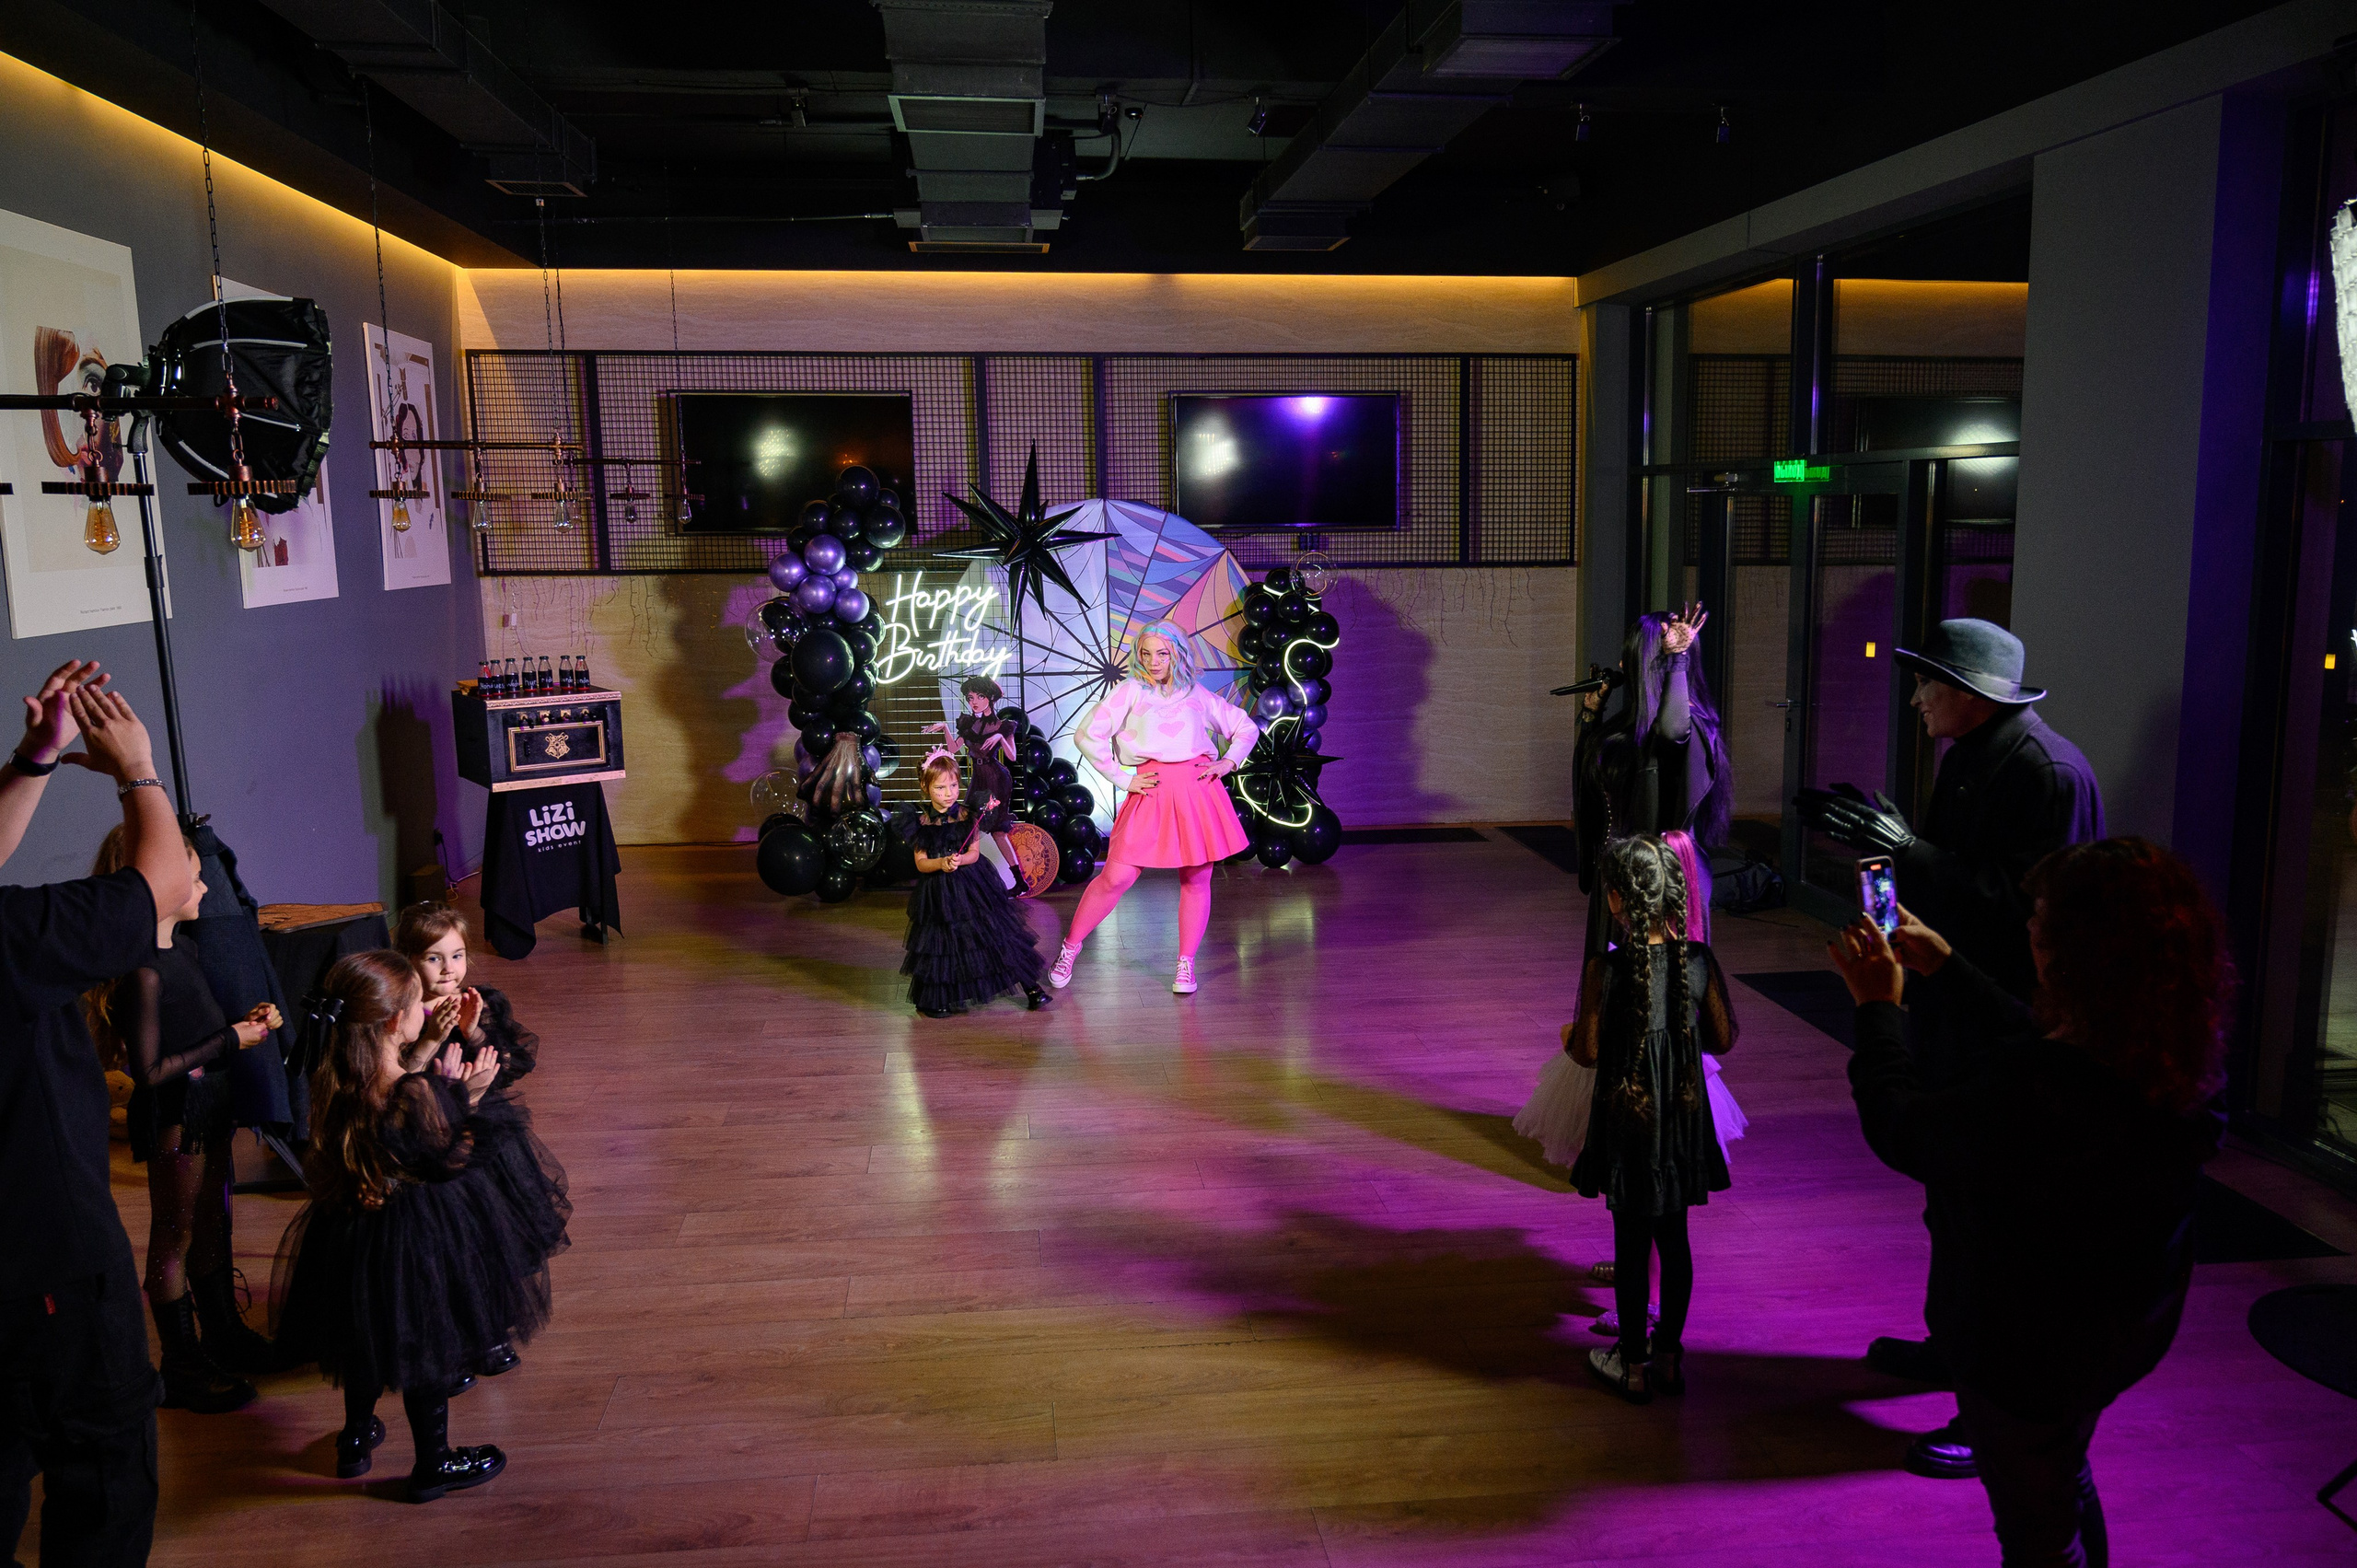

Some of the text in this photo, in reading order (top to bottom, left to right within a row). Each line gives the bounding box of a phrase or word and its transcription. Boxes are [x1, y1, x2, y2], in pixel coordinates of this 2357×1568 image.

[885, 570, 1000, 637] Happy
[875, 622, 1013, 683] Birthday
[526, 820, 586, 846] SHOW
[529, 801, 575, 827] LiZi
